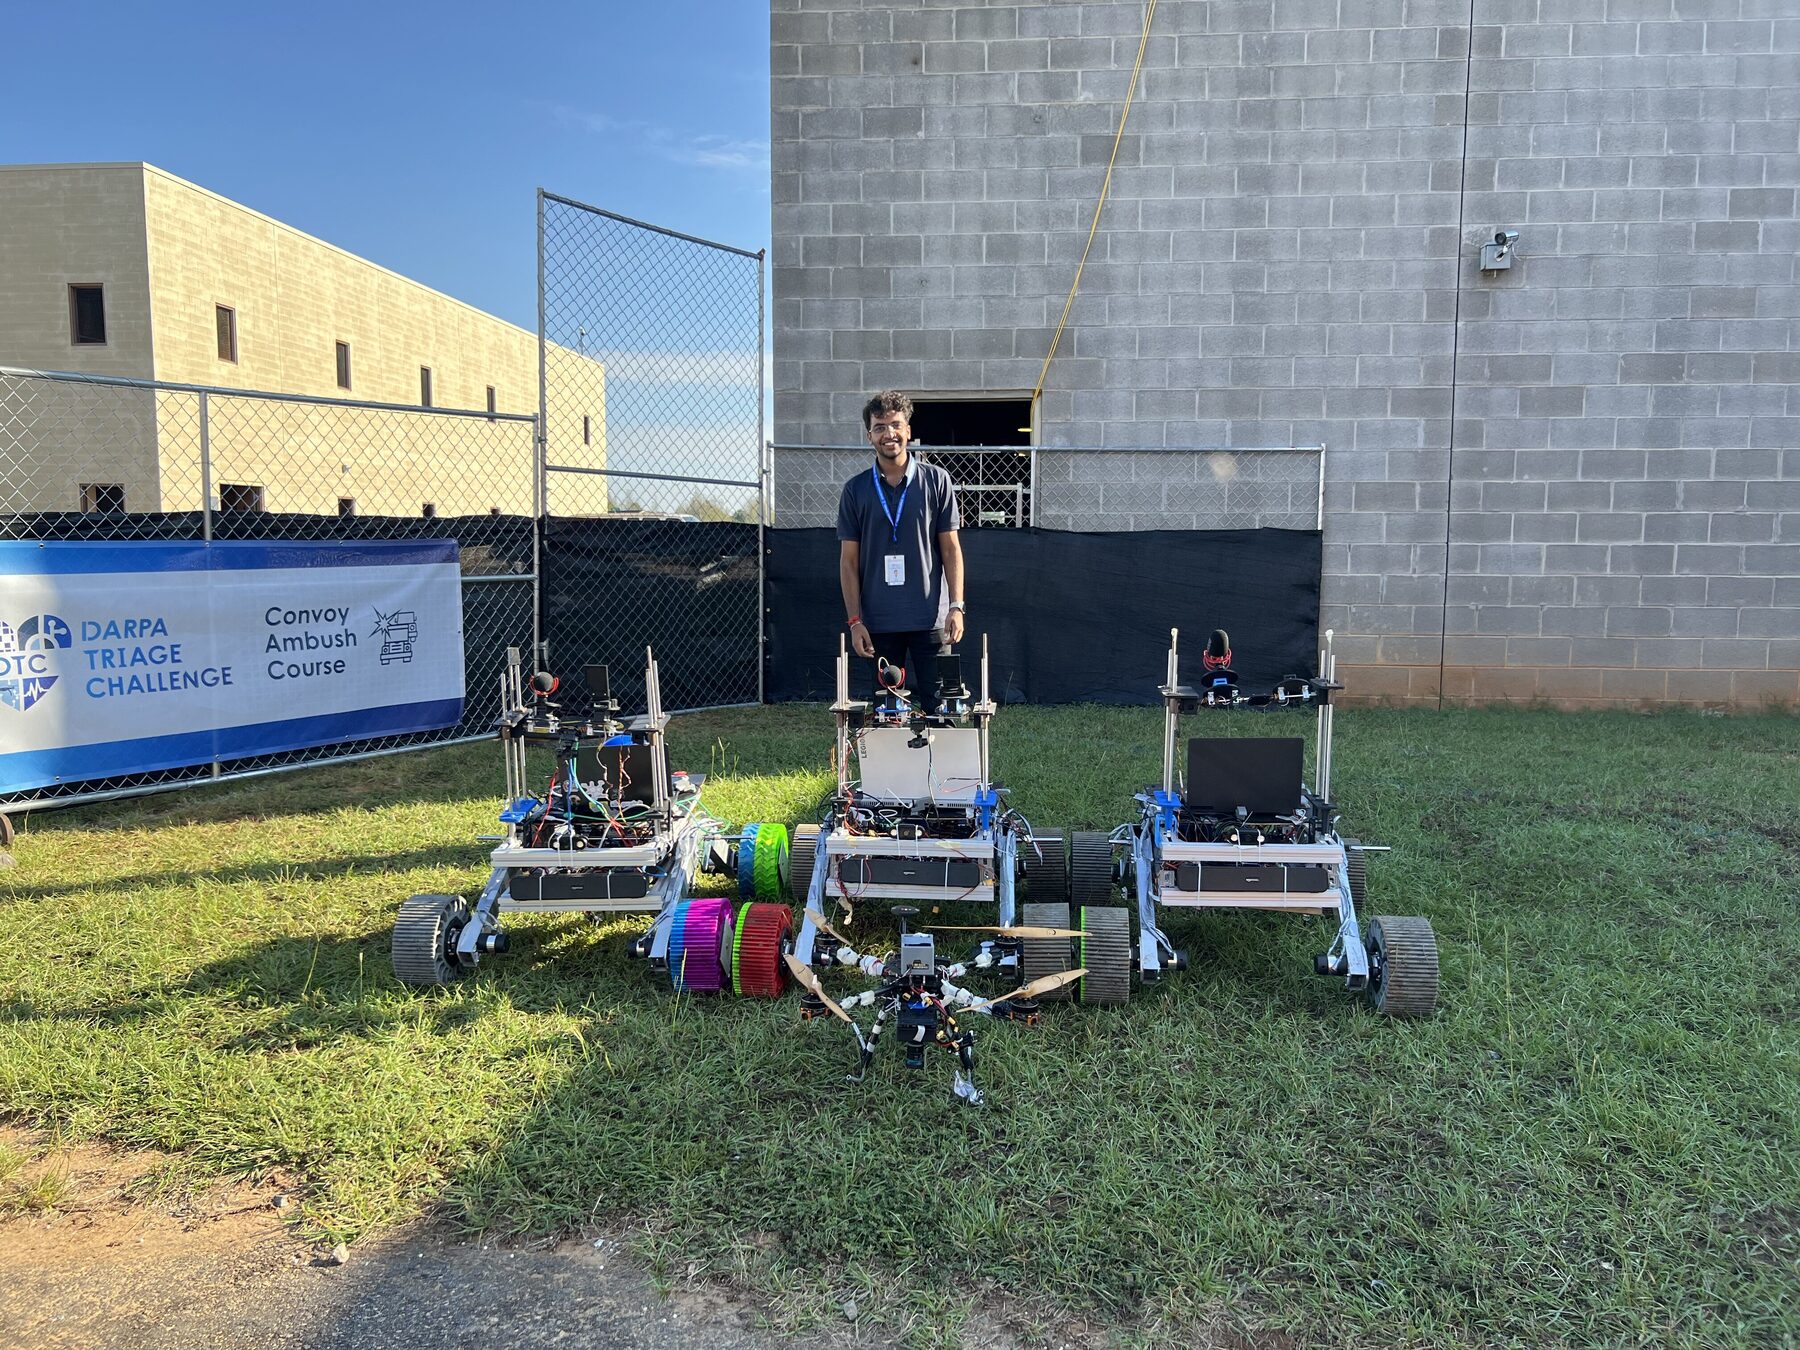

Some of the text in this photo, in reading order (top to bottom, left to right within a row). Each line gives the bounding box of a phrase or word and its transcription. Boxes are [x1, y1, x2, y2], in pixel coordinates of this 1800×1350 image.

[265, 606, 350, 626] Convoy
[81, 618, 168, 641] DARPA
[265, 628, 357, 653] Ambush
[83, 643, 182, 670] TRIAGE
[267, 659, 346, 680] Course
[86, 666, 233, 698] CHALLENGE
[859, 735, 867, 758] LEGIO
